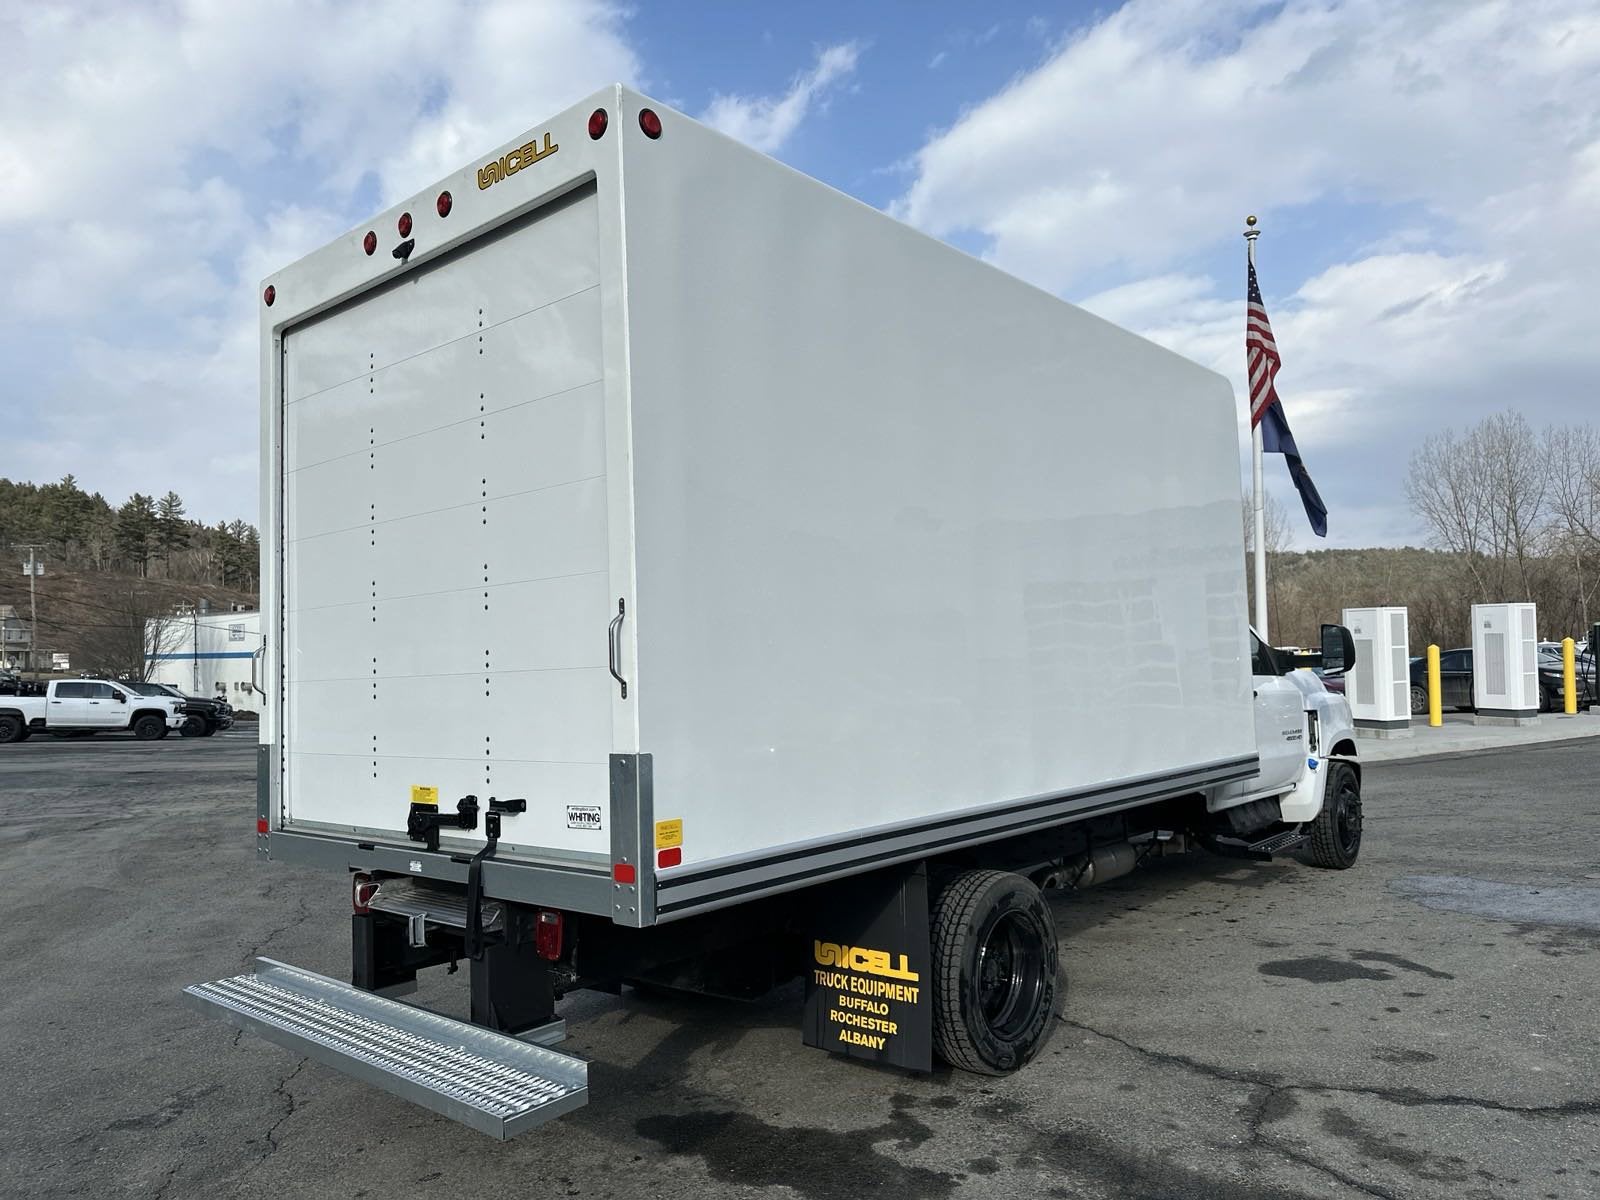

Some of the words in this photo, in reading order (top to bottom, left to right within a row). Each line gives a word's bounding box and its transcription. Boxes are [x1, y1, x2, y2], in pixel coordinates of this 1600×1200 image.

[478, 132, 559, 190] UNICELL
[568, 812, 600, 823] WHITING
[814, 940, 919, 982] UNICELL
[814, 970, 849, 990] TRUCK
[850, 976, 919, 1004] EQUIPMENT
[839, 995, 889, 1016] BUFFALO
[830, 1009, 898, 1035] ROCHESTER
[839, 1029, 886, 1050] ALBANY
